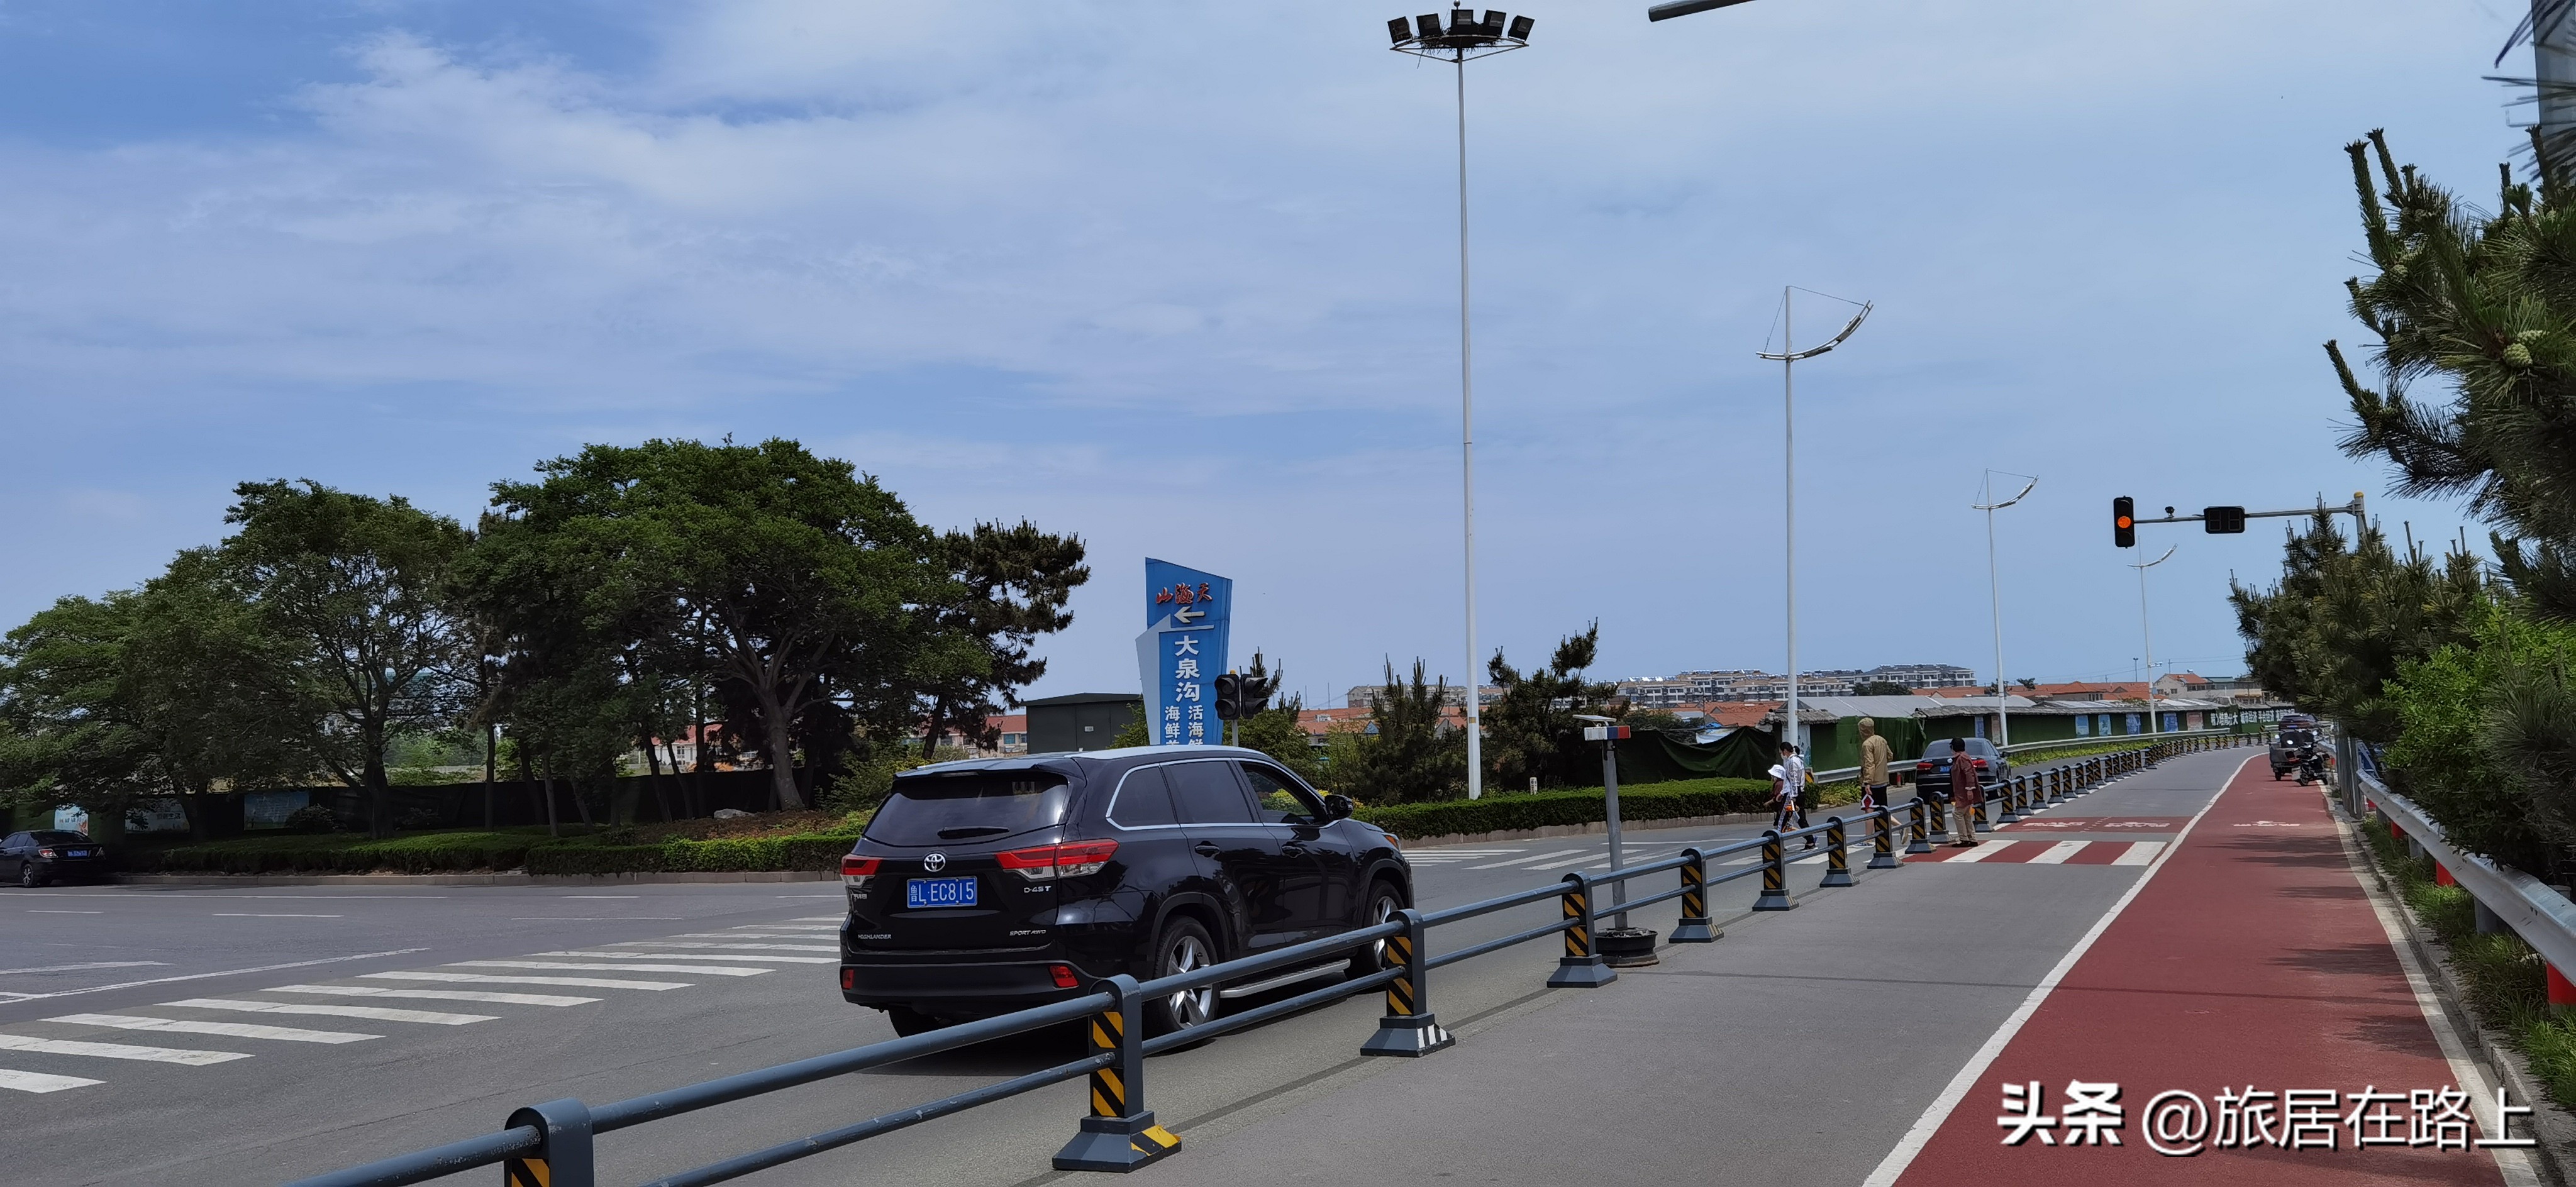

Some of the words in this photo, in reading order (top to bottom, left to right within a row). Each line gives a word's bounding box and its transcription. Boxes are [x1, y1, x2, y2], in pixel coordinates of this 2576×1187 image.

[1155, 582, 1213, 604] 山海天
[1174, 635, 1201, 703] 大泉沟
[1165, 705, 1180, 745] 海鲜
